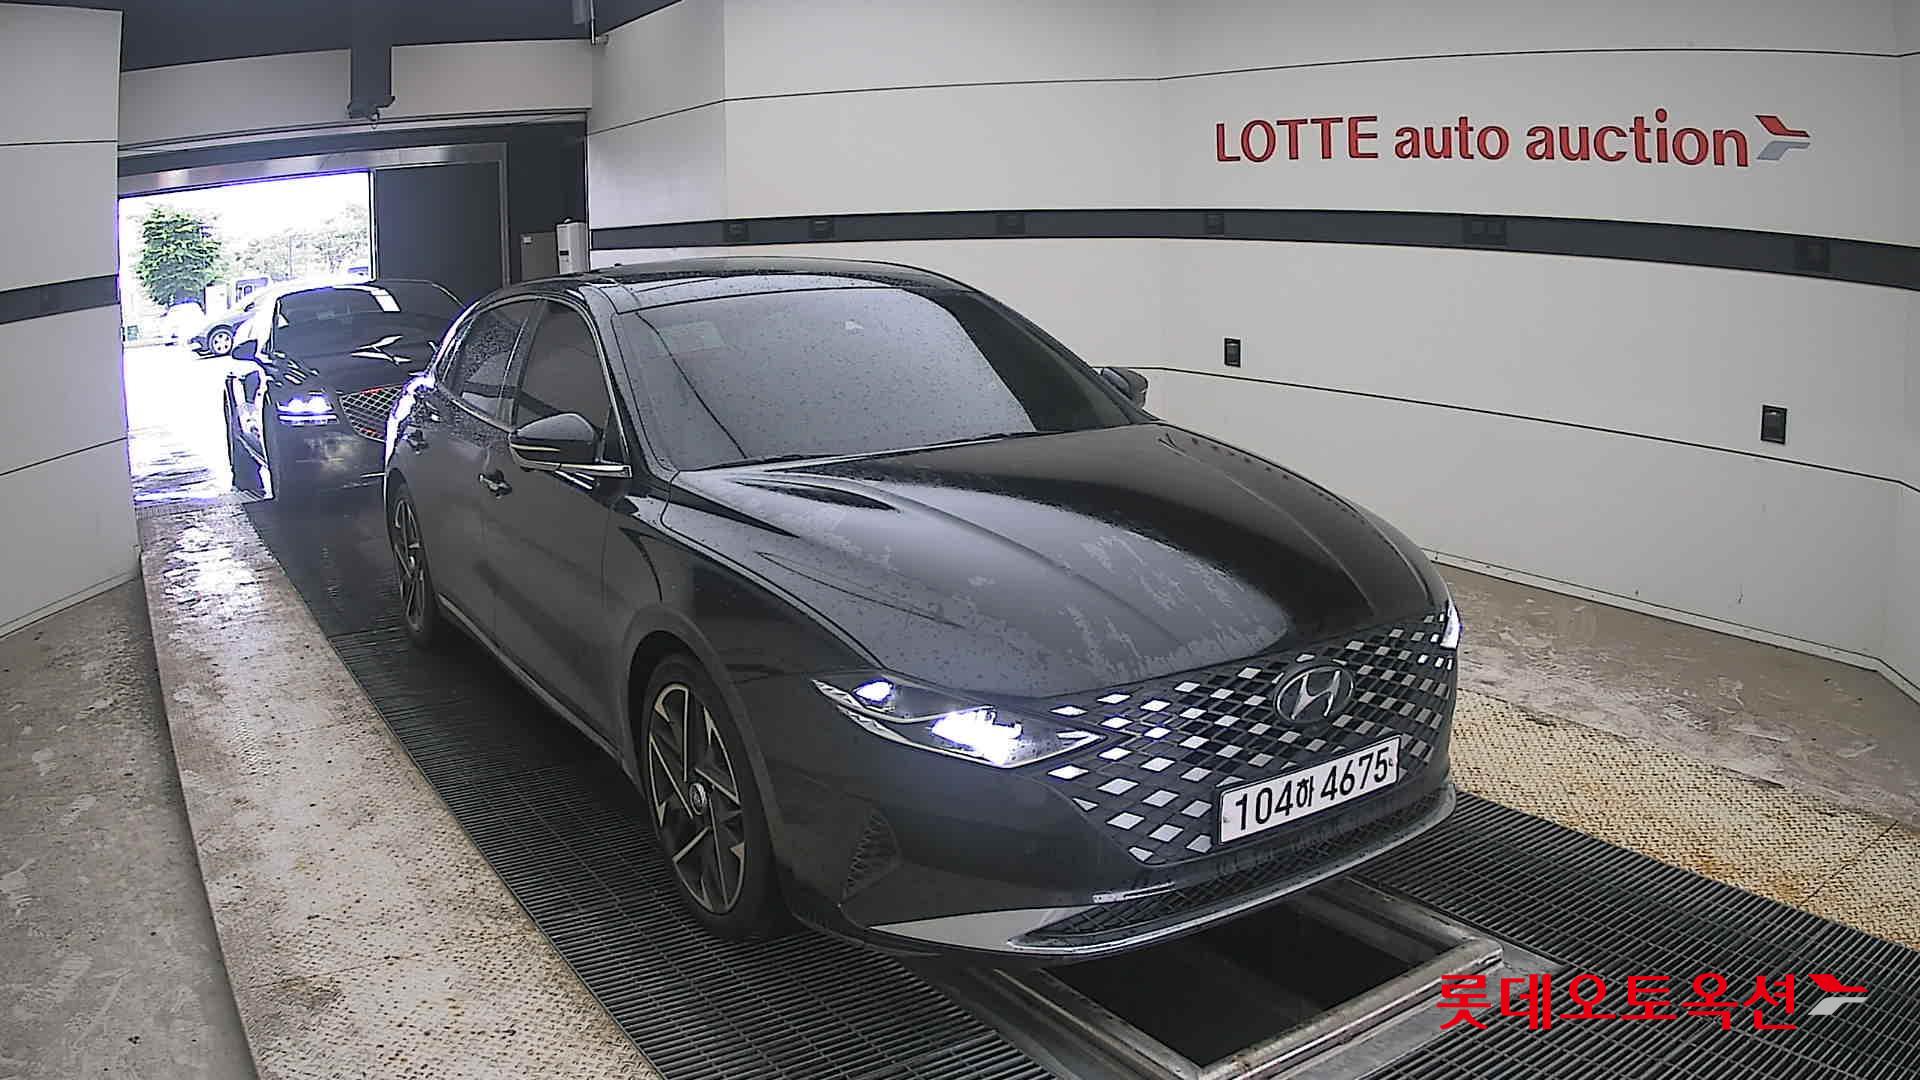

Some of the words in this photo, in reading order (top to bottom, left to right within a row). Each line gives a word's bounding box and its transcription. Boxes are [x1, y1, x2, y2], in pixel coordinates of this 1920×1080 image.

[1215, 115, 1379, 162] LOTTE
[1394, 116, 1510, 160] auto
[1526, 108, 1749, 167] auction
[1235, 775, 1315, 831] 104하
[1320, 747, 1391, 801] 4675
